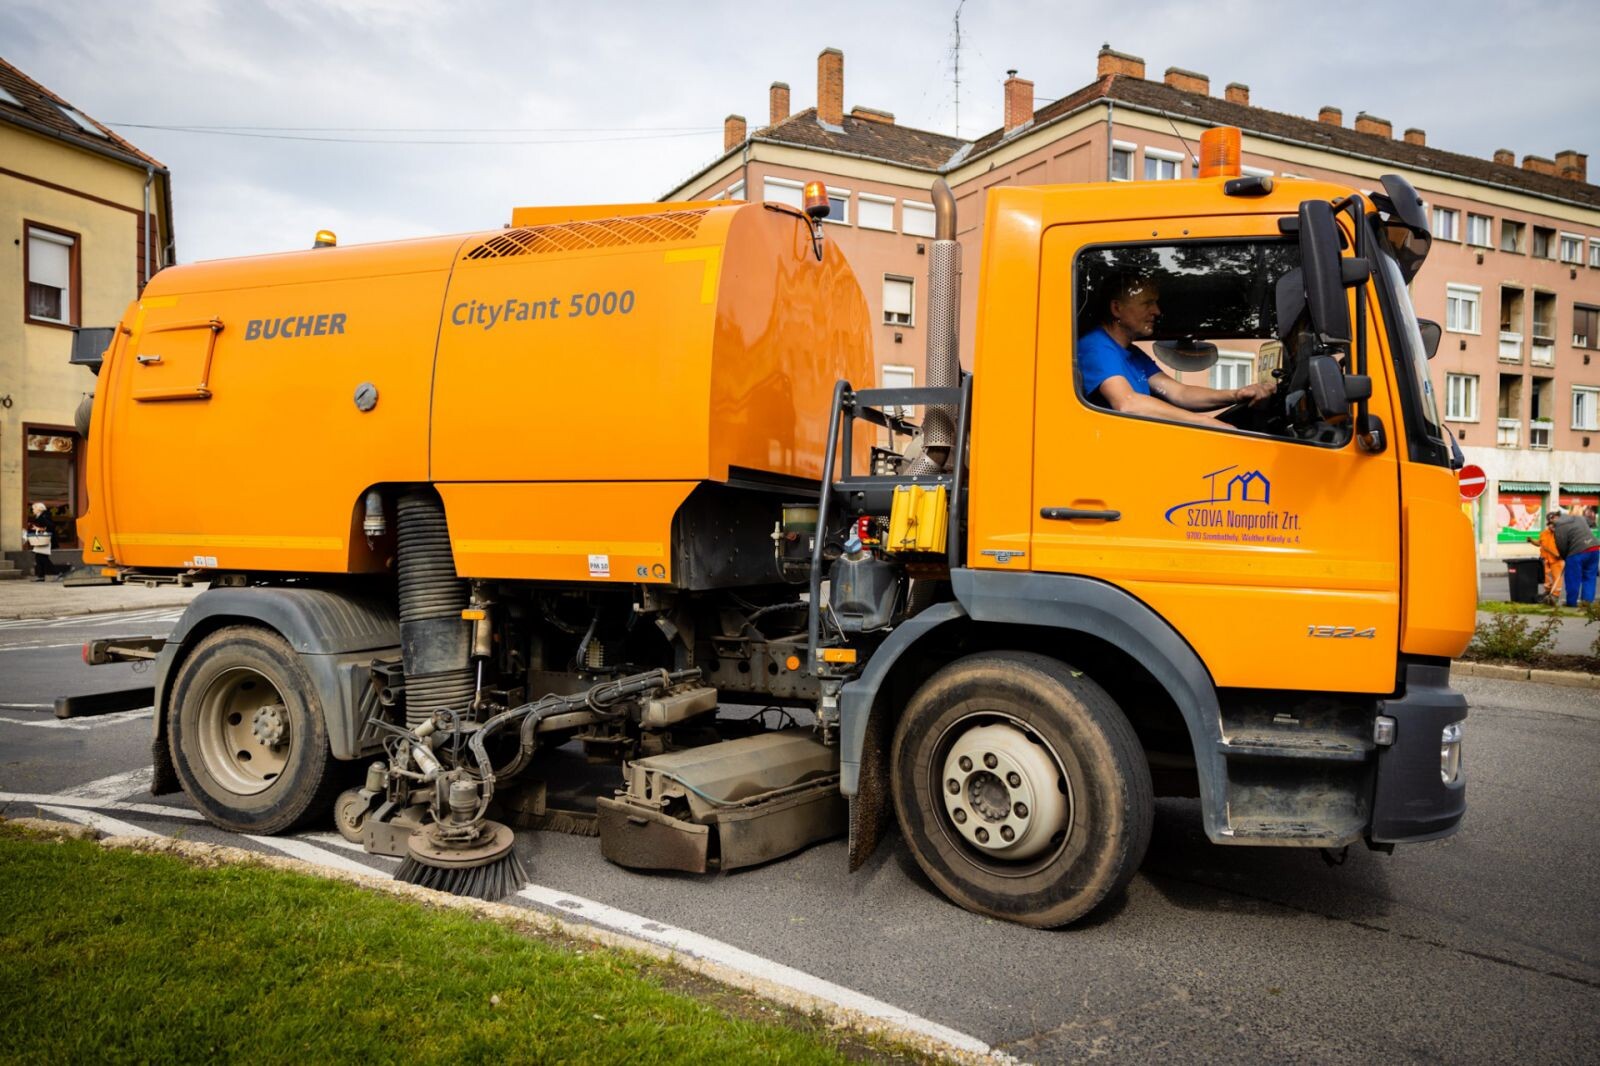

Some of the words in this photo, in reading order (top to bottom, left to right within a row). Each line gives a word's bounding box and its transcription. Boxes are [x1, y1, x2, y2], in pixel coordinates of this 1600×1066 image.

[451, 296, 560, 331] CityFant
[568, 290, 635, 318] 5000
[244, 312, 347, 341] BUCHER
[1187, 509, 1223, 527] SZOVA
[1227, 510, 1279, 530] Nonprofit
[1281, 511, 1301, 530] Zrt.
[1307, 625, 1376, 639] 1324
